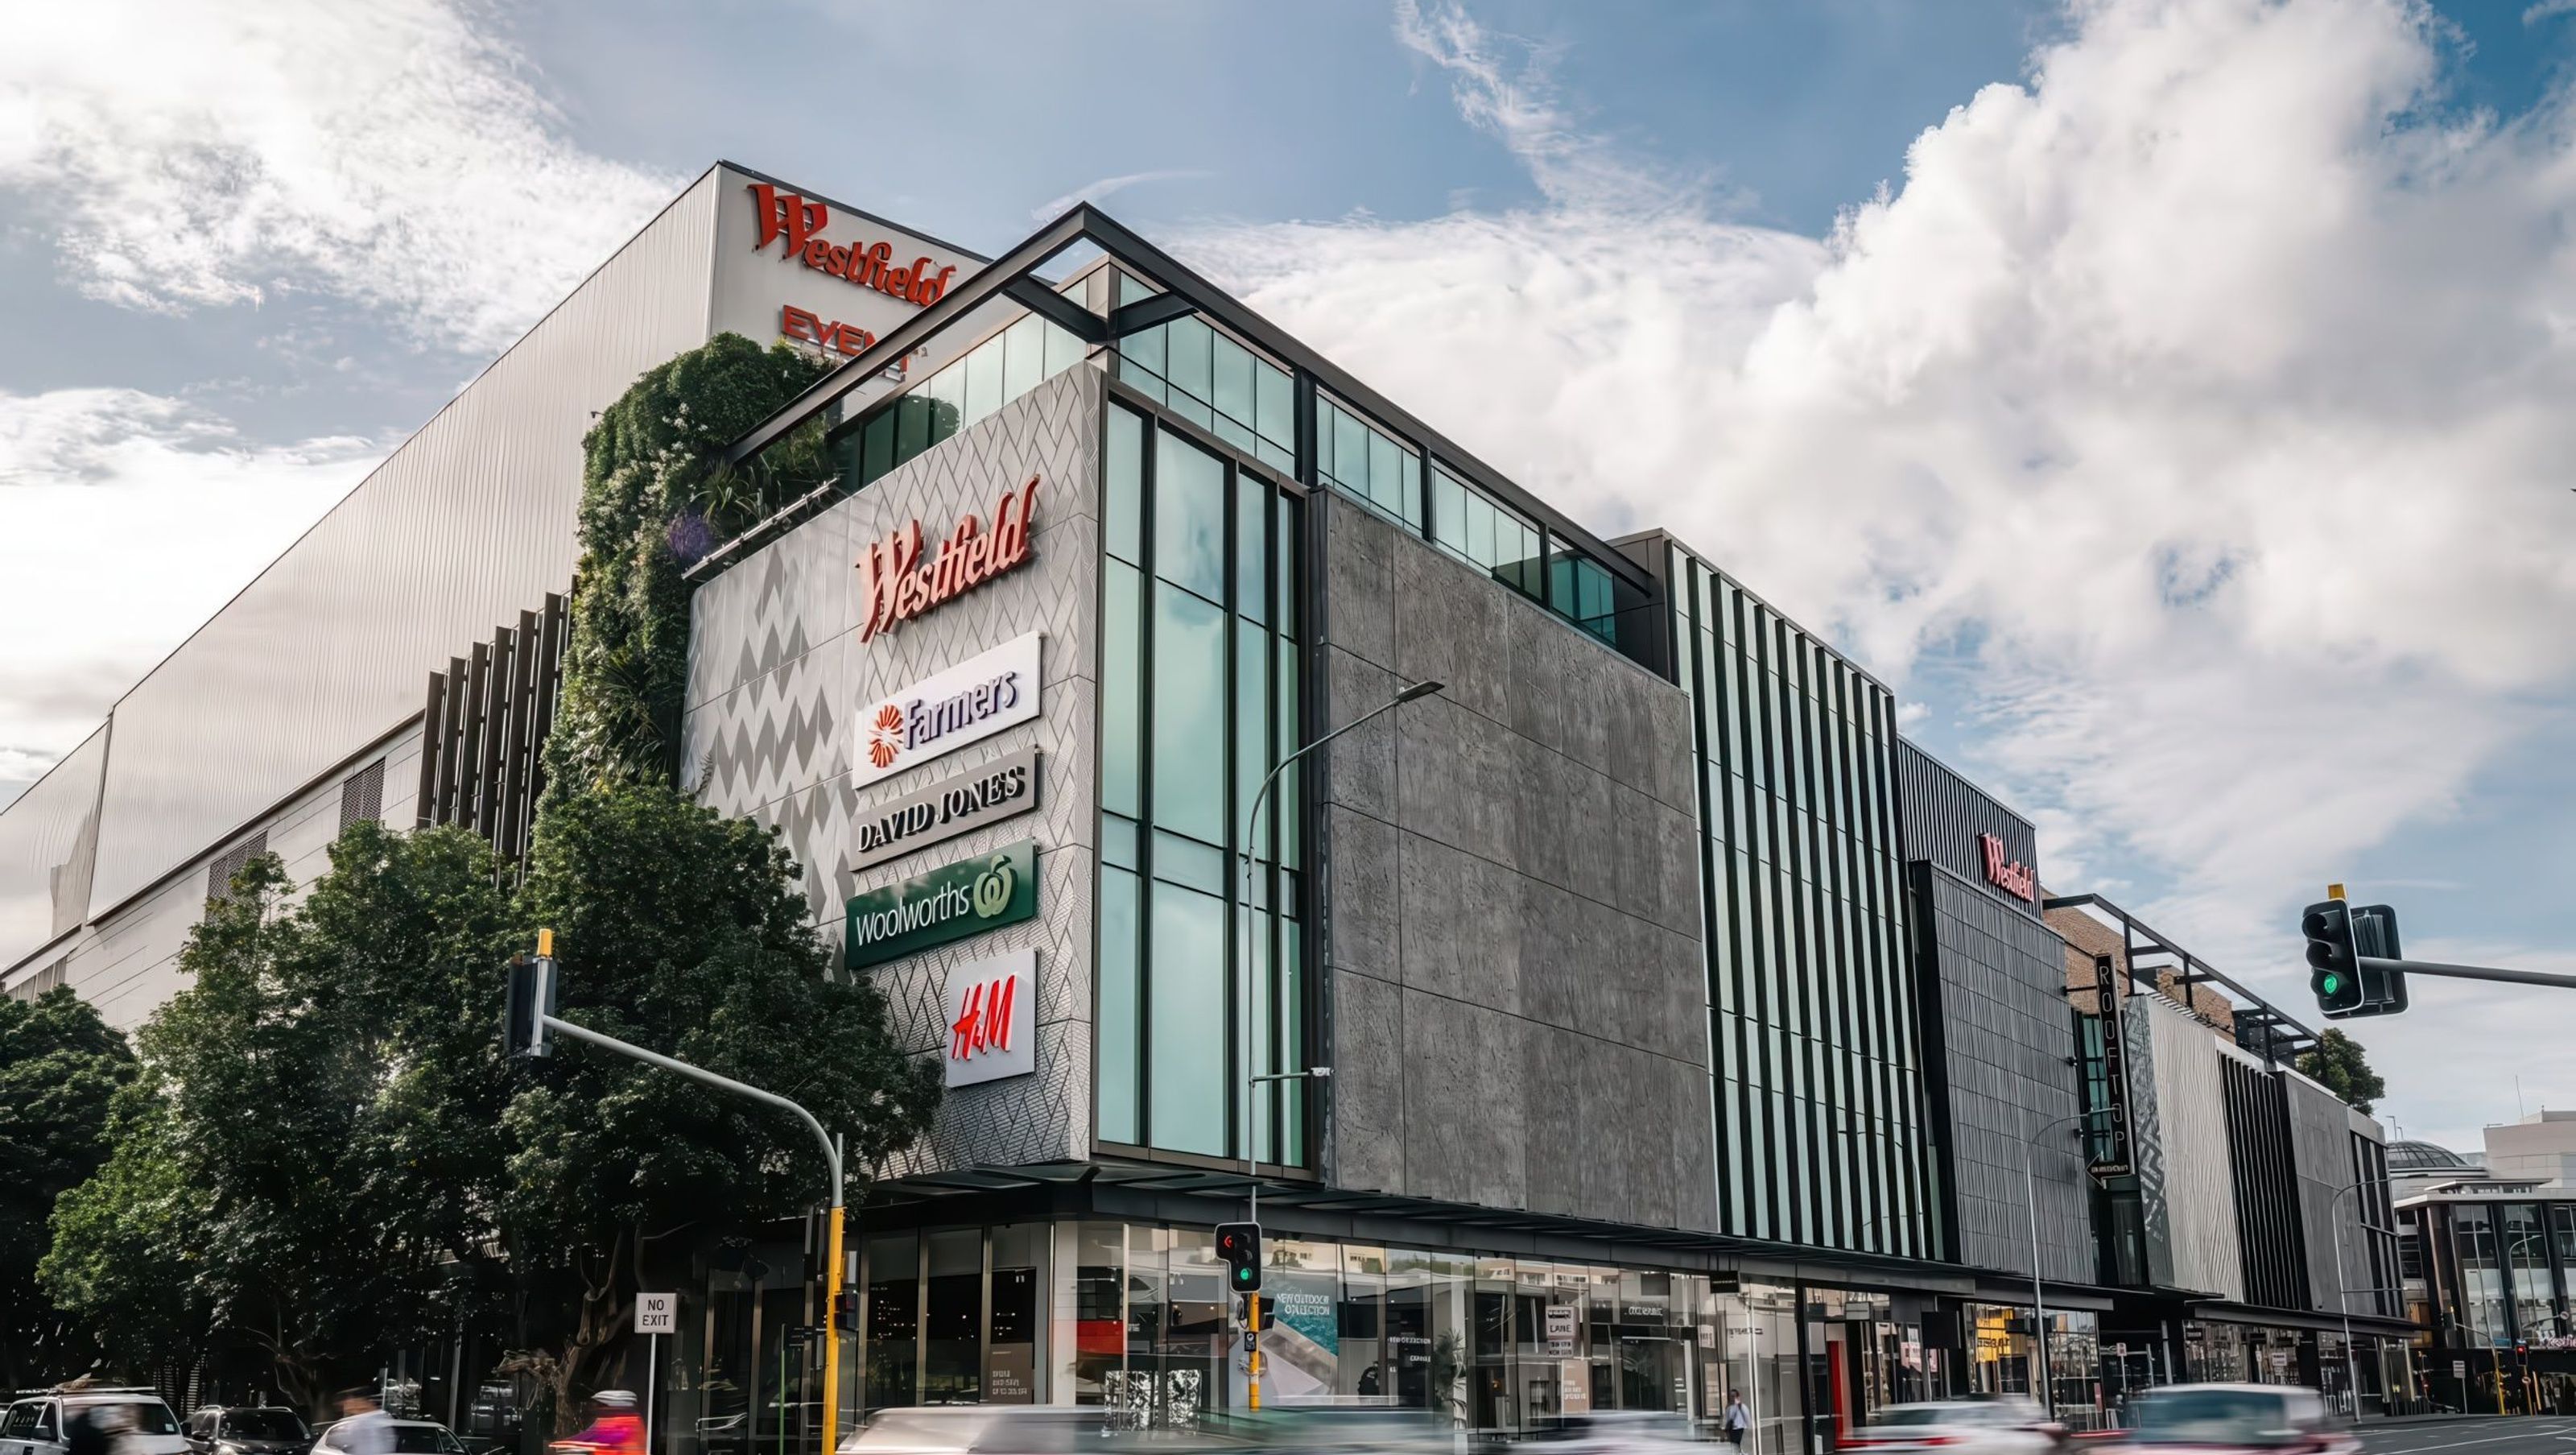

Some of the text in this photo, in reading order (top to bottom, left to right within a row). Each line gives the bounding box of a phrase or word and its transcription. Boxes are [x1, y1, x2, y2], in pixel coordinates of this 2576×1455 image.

[746, 184, 956, 306] Westfield
[783, 304, 909, 375] EVE
[856, 473, 1040, 643] Westfield
[905, 671, 1018, 750] Farmers
[858, 766, 1025, 852] DAVID JONES
[1978, 833, 2034, 903] Westfield
[952, 973, 1017, 1061] H&M
[2099, 965, 2126, 1154] ROOFTOP
[642, 1314, 669, 1326] EXIT
[648, 1299, 665, 1311] NO
